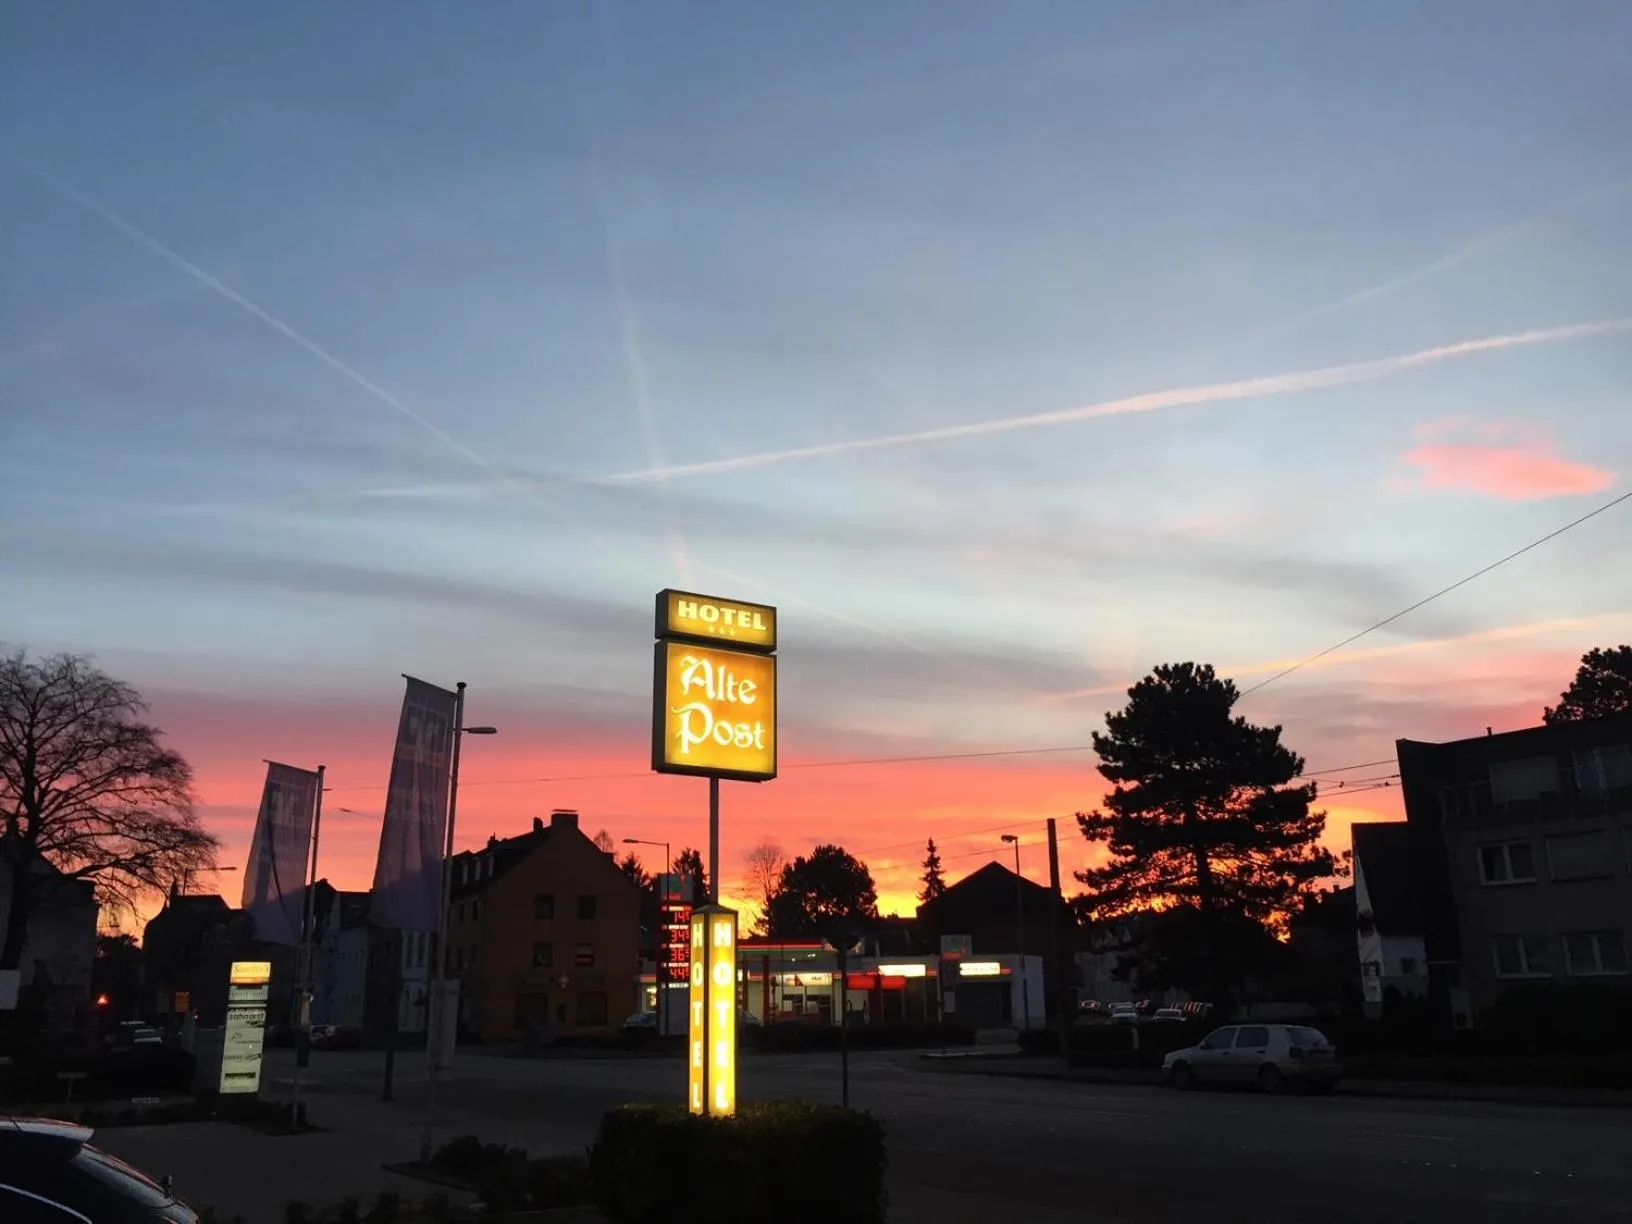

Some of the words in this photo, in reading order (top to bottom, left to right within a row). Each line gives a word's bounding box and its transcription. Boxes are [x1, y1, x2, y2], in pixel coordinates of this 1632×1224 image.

[678, 600, 766, 631] HOTEL
[680, 655, 757, 704] Alte
[671, 702, 765, 754] Post
[713, 921, 733, 1110] HOTEL
